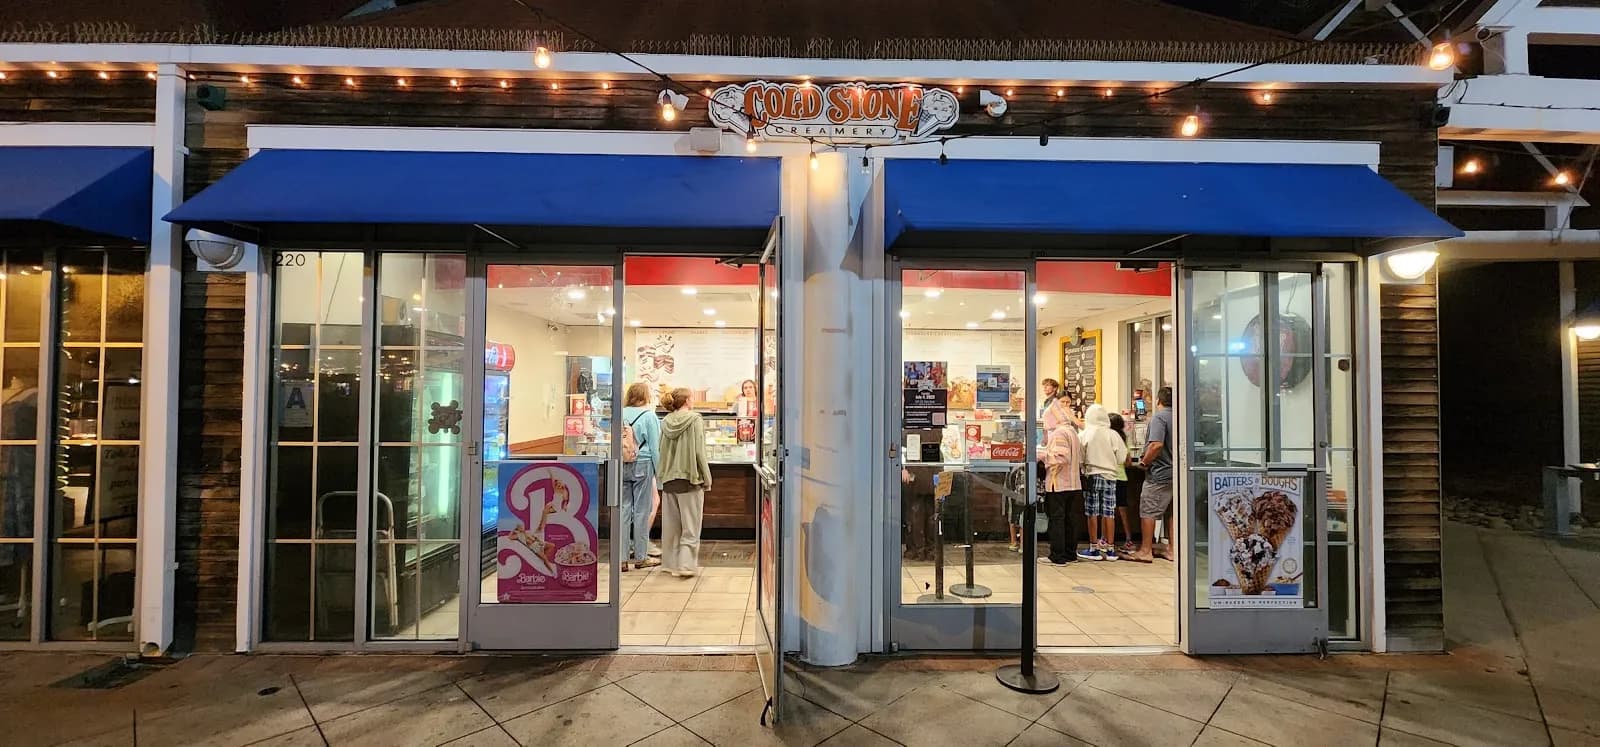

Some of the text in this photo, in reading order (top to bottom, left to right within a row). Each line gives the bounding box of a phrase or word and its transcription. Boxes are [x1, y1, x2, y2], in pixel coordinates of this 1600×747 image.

[743, 84, 923, 130] COLD STONE
[775, 126, 888, 136] CREAMERY
[274, 253, 306, 267] 220
[286, 387, 306, 409] A
[992, 446, 1021, 457] Coca-Cola
[1214, 476, 1254, 491] BATTERS
[1261, 476, 1298, 491] DOUGHS
[516, 572, 546, 584] Barbie
[561, 570, 590, 583] Barbie
